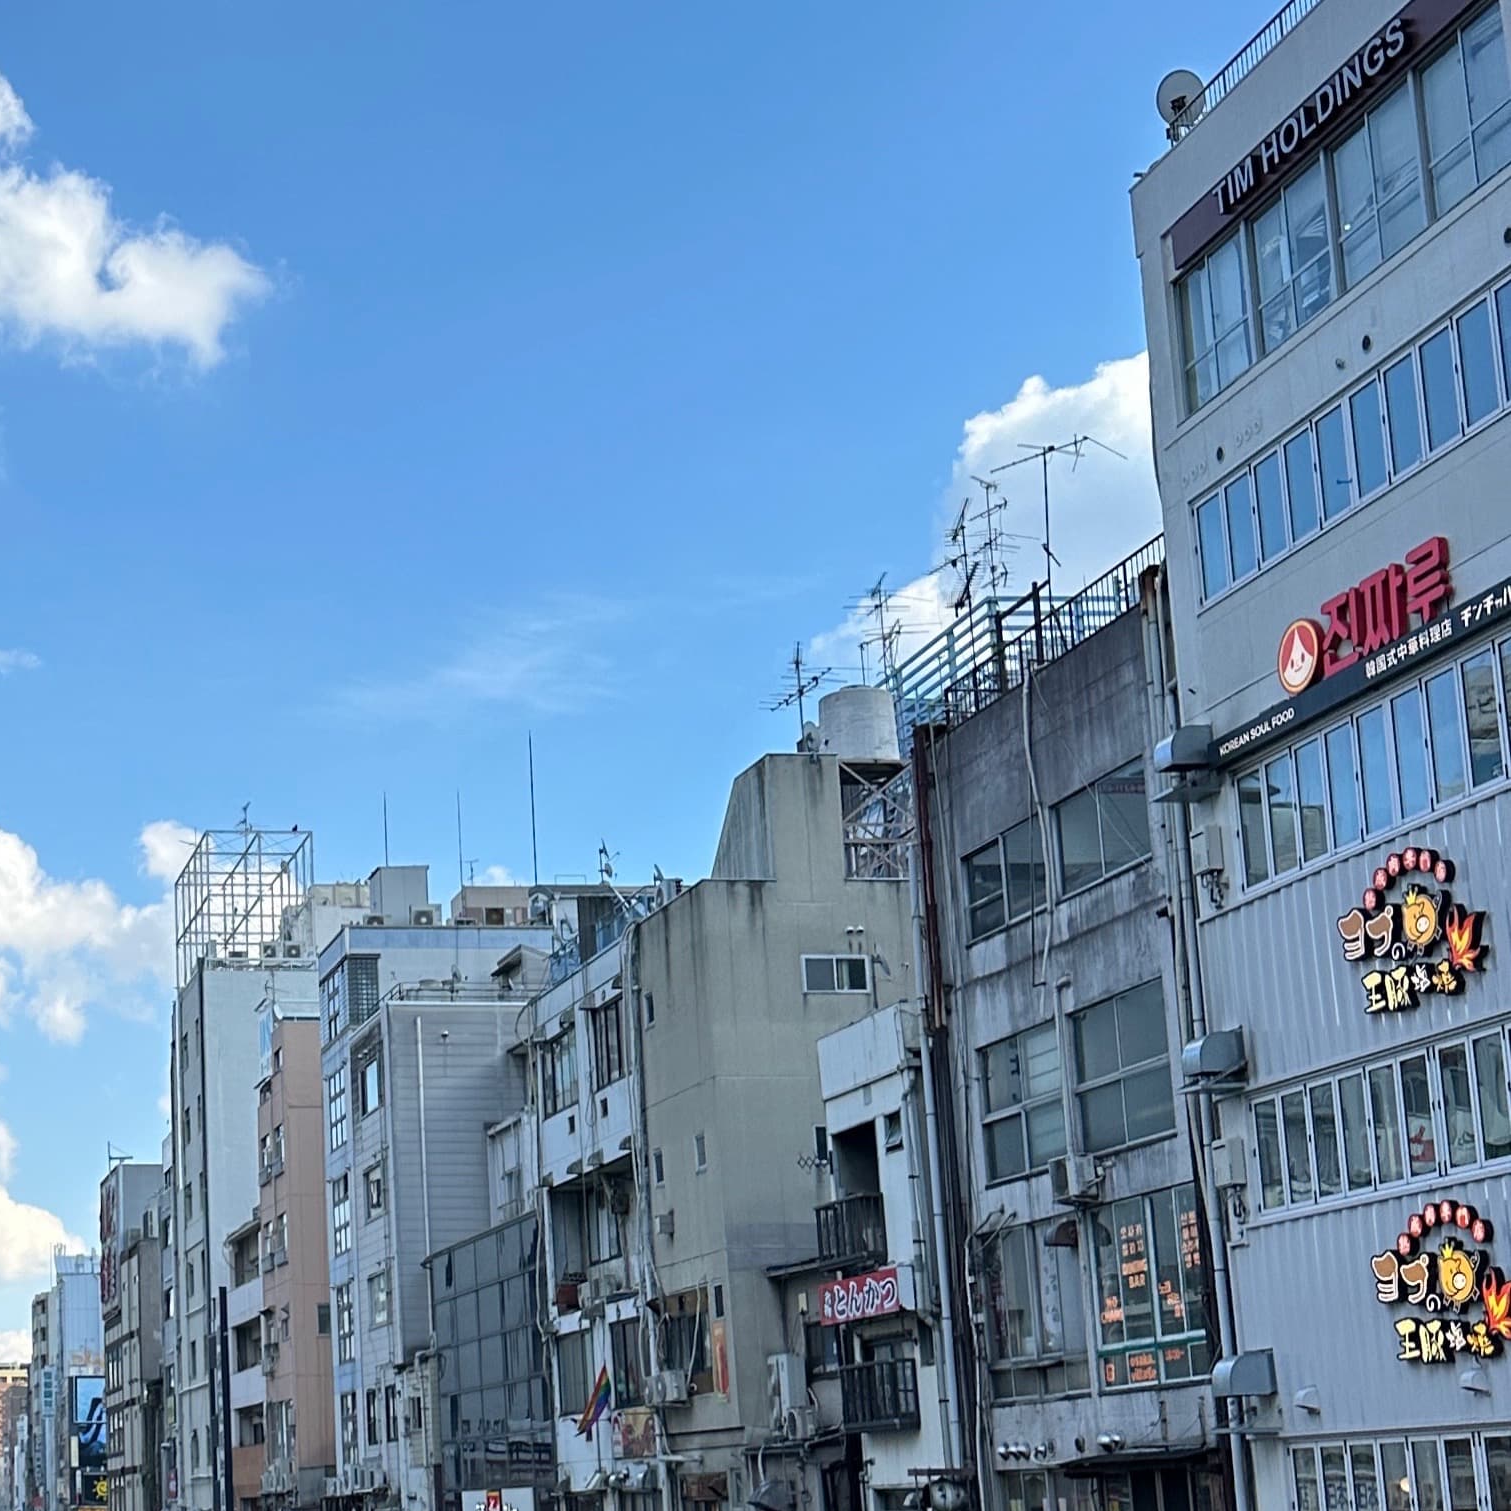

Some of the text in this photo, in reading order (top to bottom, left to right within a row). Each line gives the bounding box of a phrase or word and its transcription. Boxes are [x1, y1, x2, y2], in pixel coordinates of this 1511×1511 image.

[1212, 17, 1406, 215] TIM HOLDINGS
[1321, 536, 1451, 680] 진짜루
[1364, 617, 1453, 680] 韓国式中華料理店
[1218, 706, 1295, 758] KOREAN SOUL FOOD
[834, 1277, 897, 1320] とんかつ
